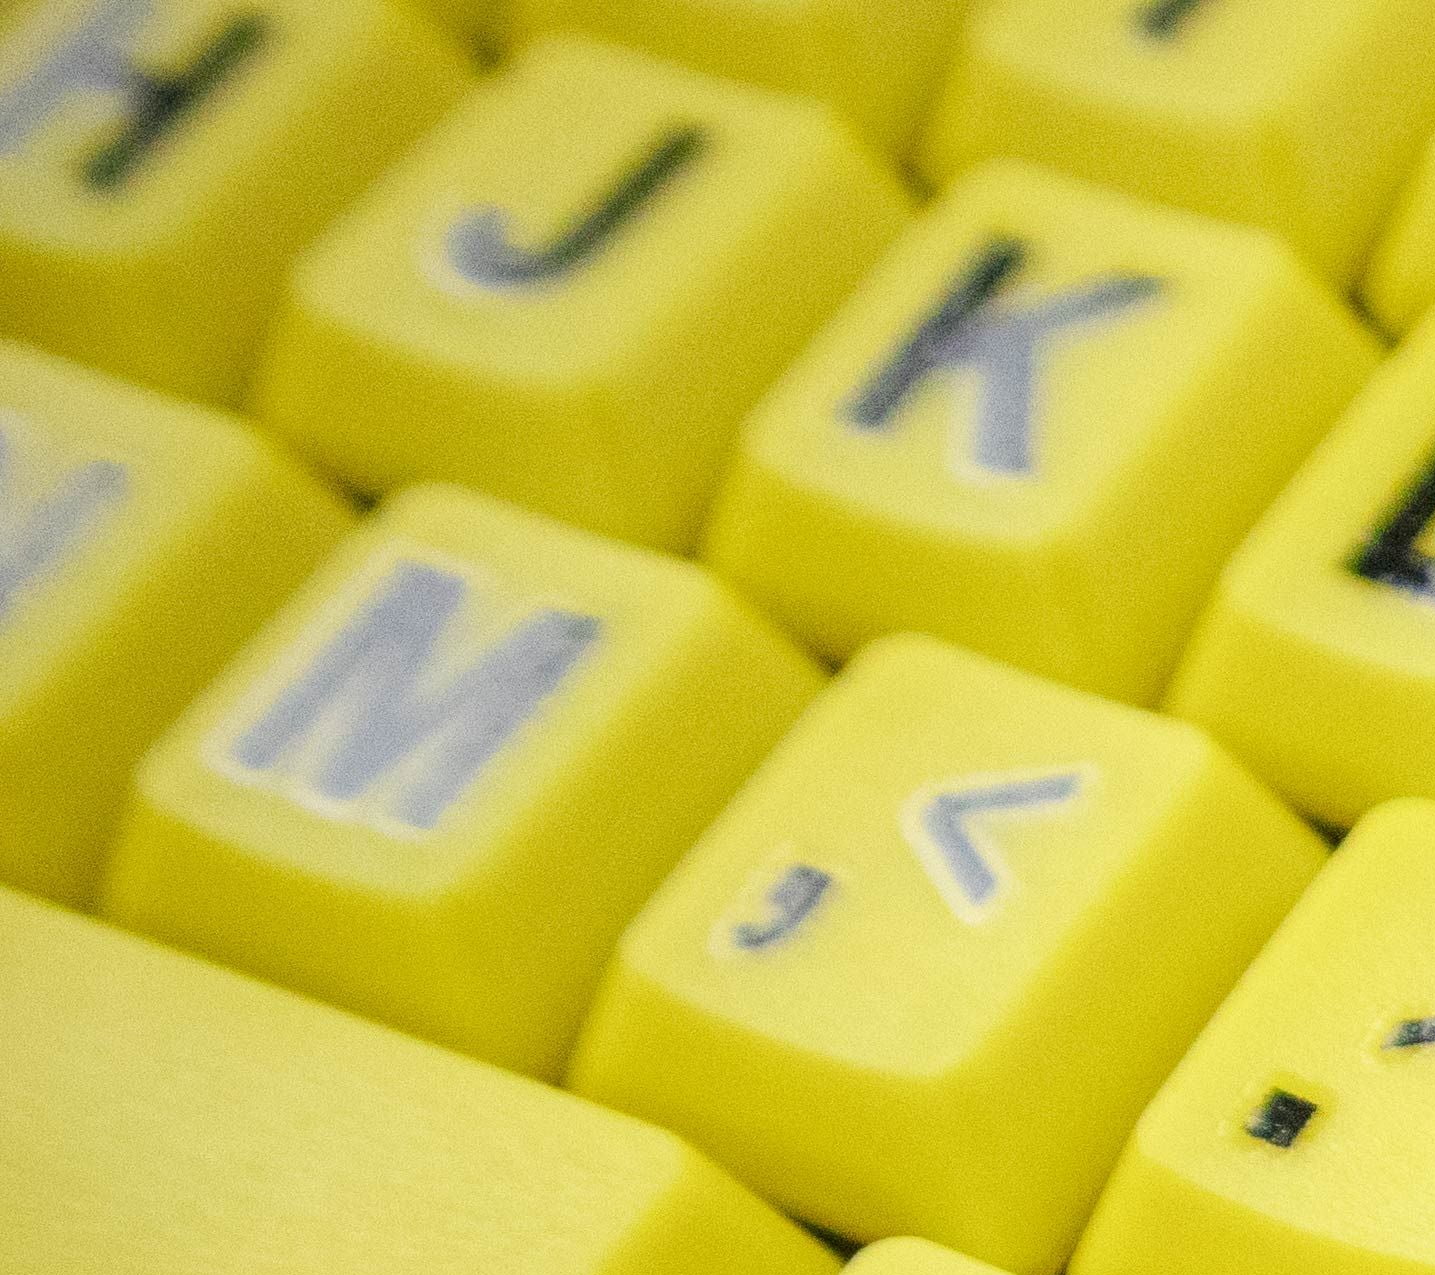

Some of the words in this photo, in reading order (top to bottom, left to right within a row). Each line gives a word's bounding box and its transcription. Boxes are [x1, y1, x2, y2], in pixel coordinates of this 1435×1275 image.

[445, 118, 713, 290] J
[840, 230, 1172, 480] K
[228, 558, 604, 830] M
